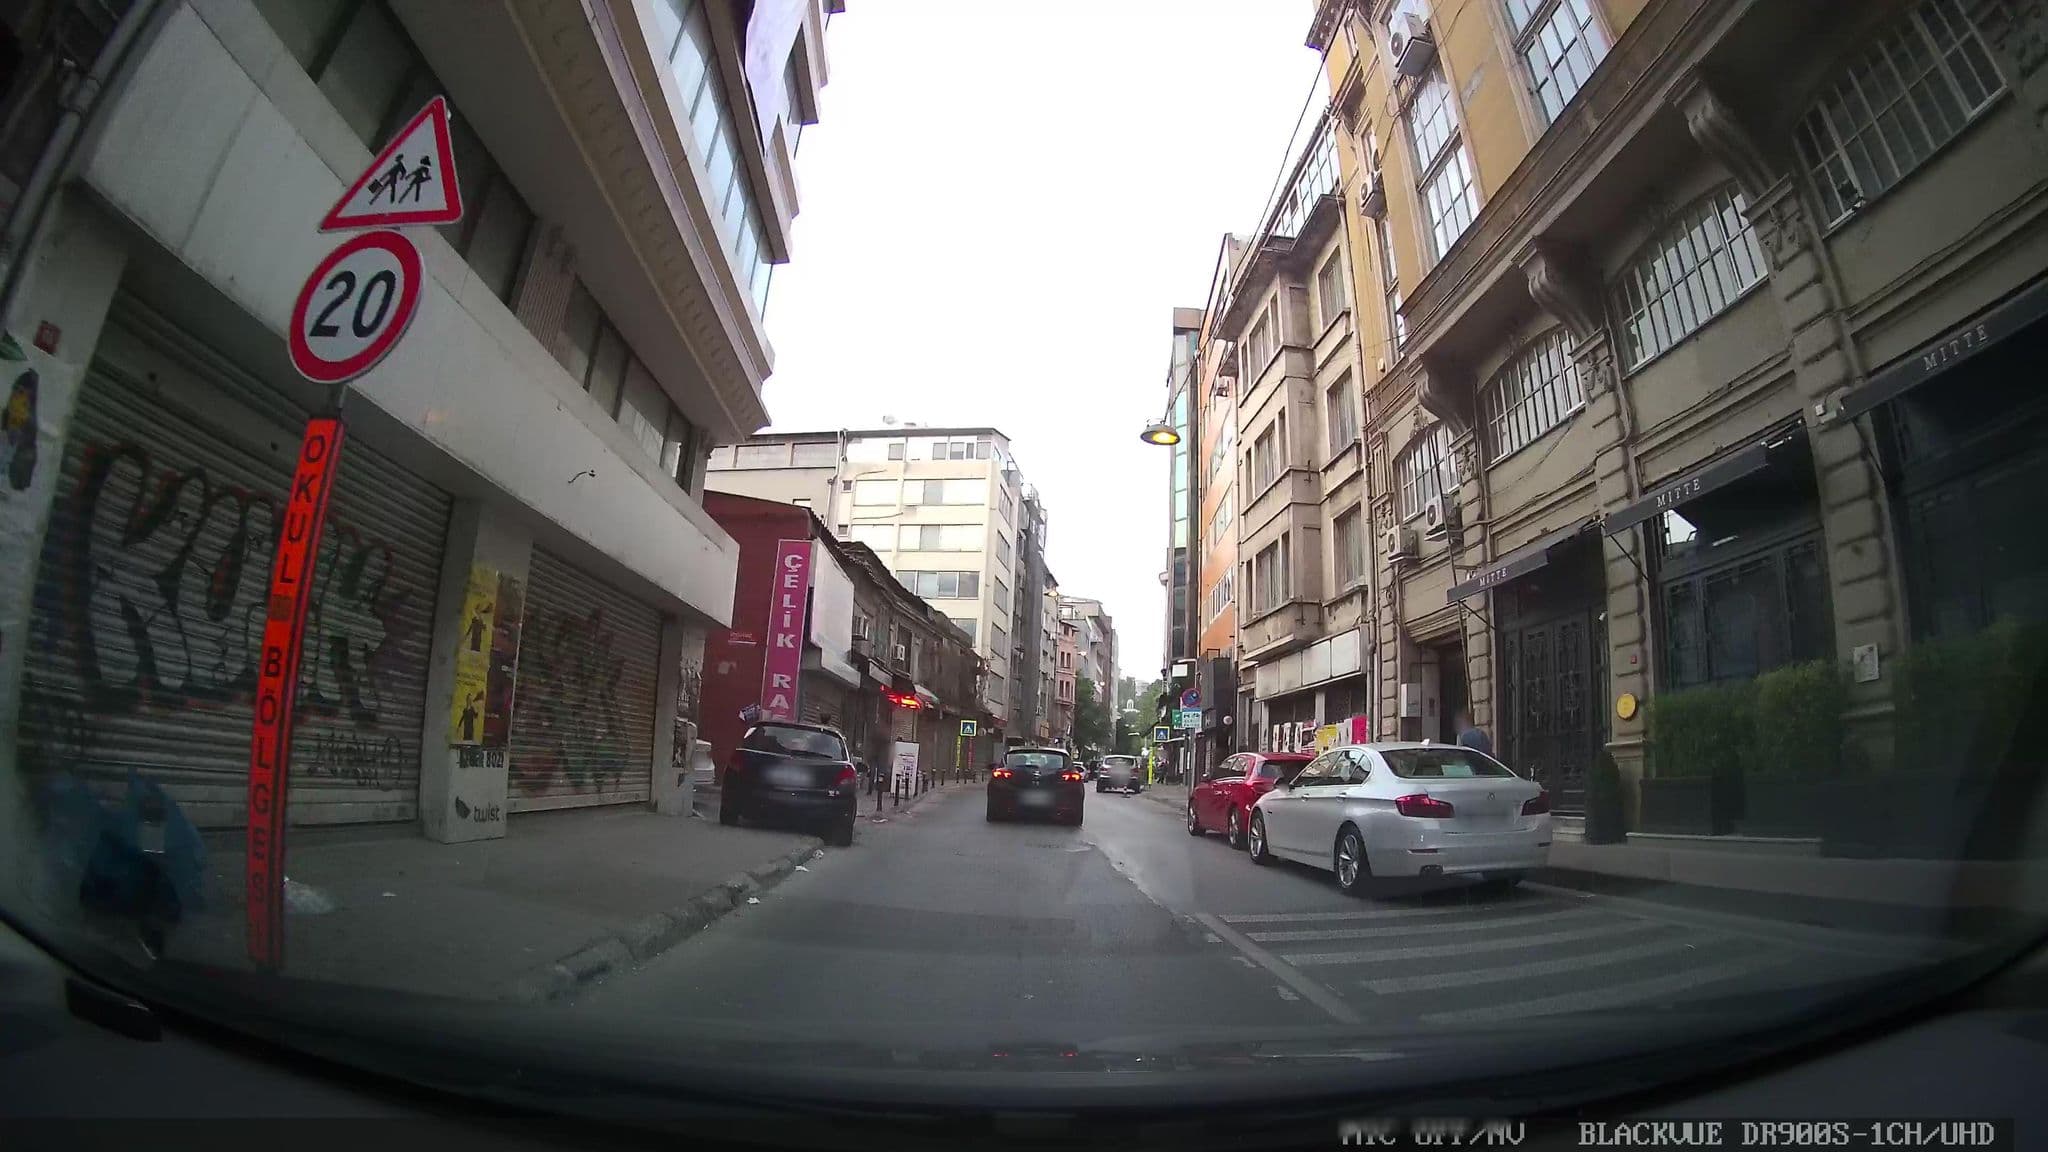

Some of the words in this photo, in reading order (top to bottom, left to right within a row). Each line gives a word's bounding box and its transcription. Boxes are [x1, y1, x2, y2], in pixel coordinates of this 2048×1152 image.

[309, 269, 397, 338] 20
[1923, 324, 1988, 371] MITTE
[279, 434, 327, 584] OKUL
[1656, 478, 1700, 507] MITTE
[1479, 567, 1508, 587] MITTE
[776, 554, 804, 649] ÇELİK
[473, 802, 500, 823] twist
